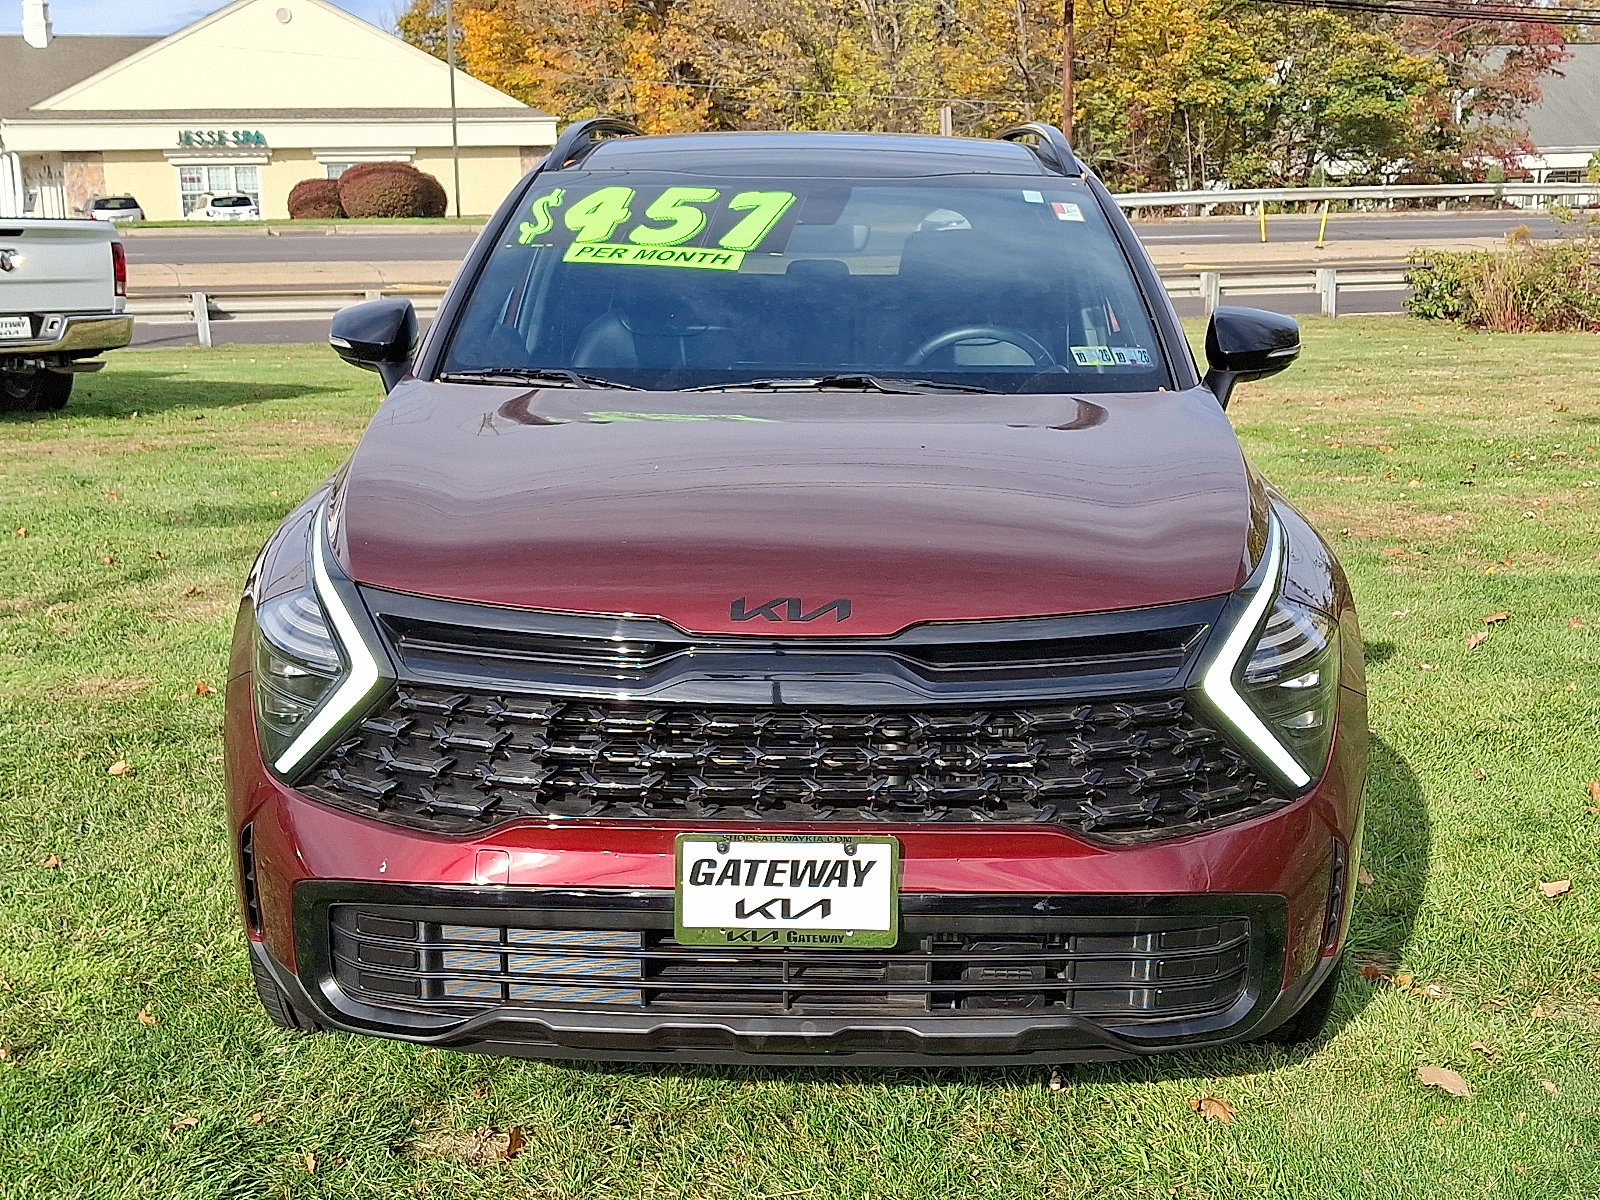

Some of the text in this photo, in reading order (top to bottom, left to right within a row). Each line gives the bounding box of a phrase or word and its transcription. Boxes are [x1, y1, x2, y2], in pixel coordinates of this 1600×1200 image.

[176, 130, 265, 146] JESSE SPA
[574, 246, 732, 265] PER MONTH
[1138, 350, 1149, 363] 26
[730, 597, 851, 622] KIA
[689, 858, 877, 888] GATEWAY
[735, 898, 831, 919] KIA
[726, 930, 779, 943] KIA
